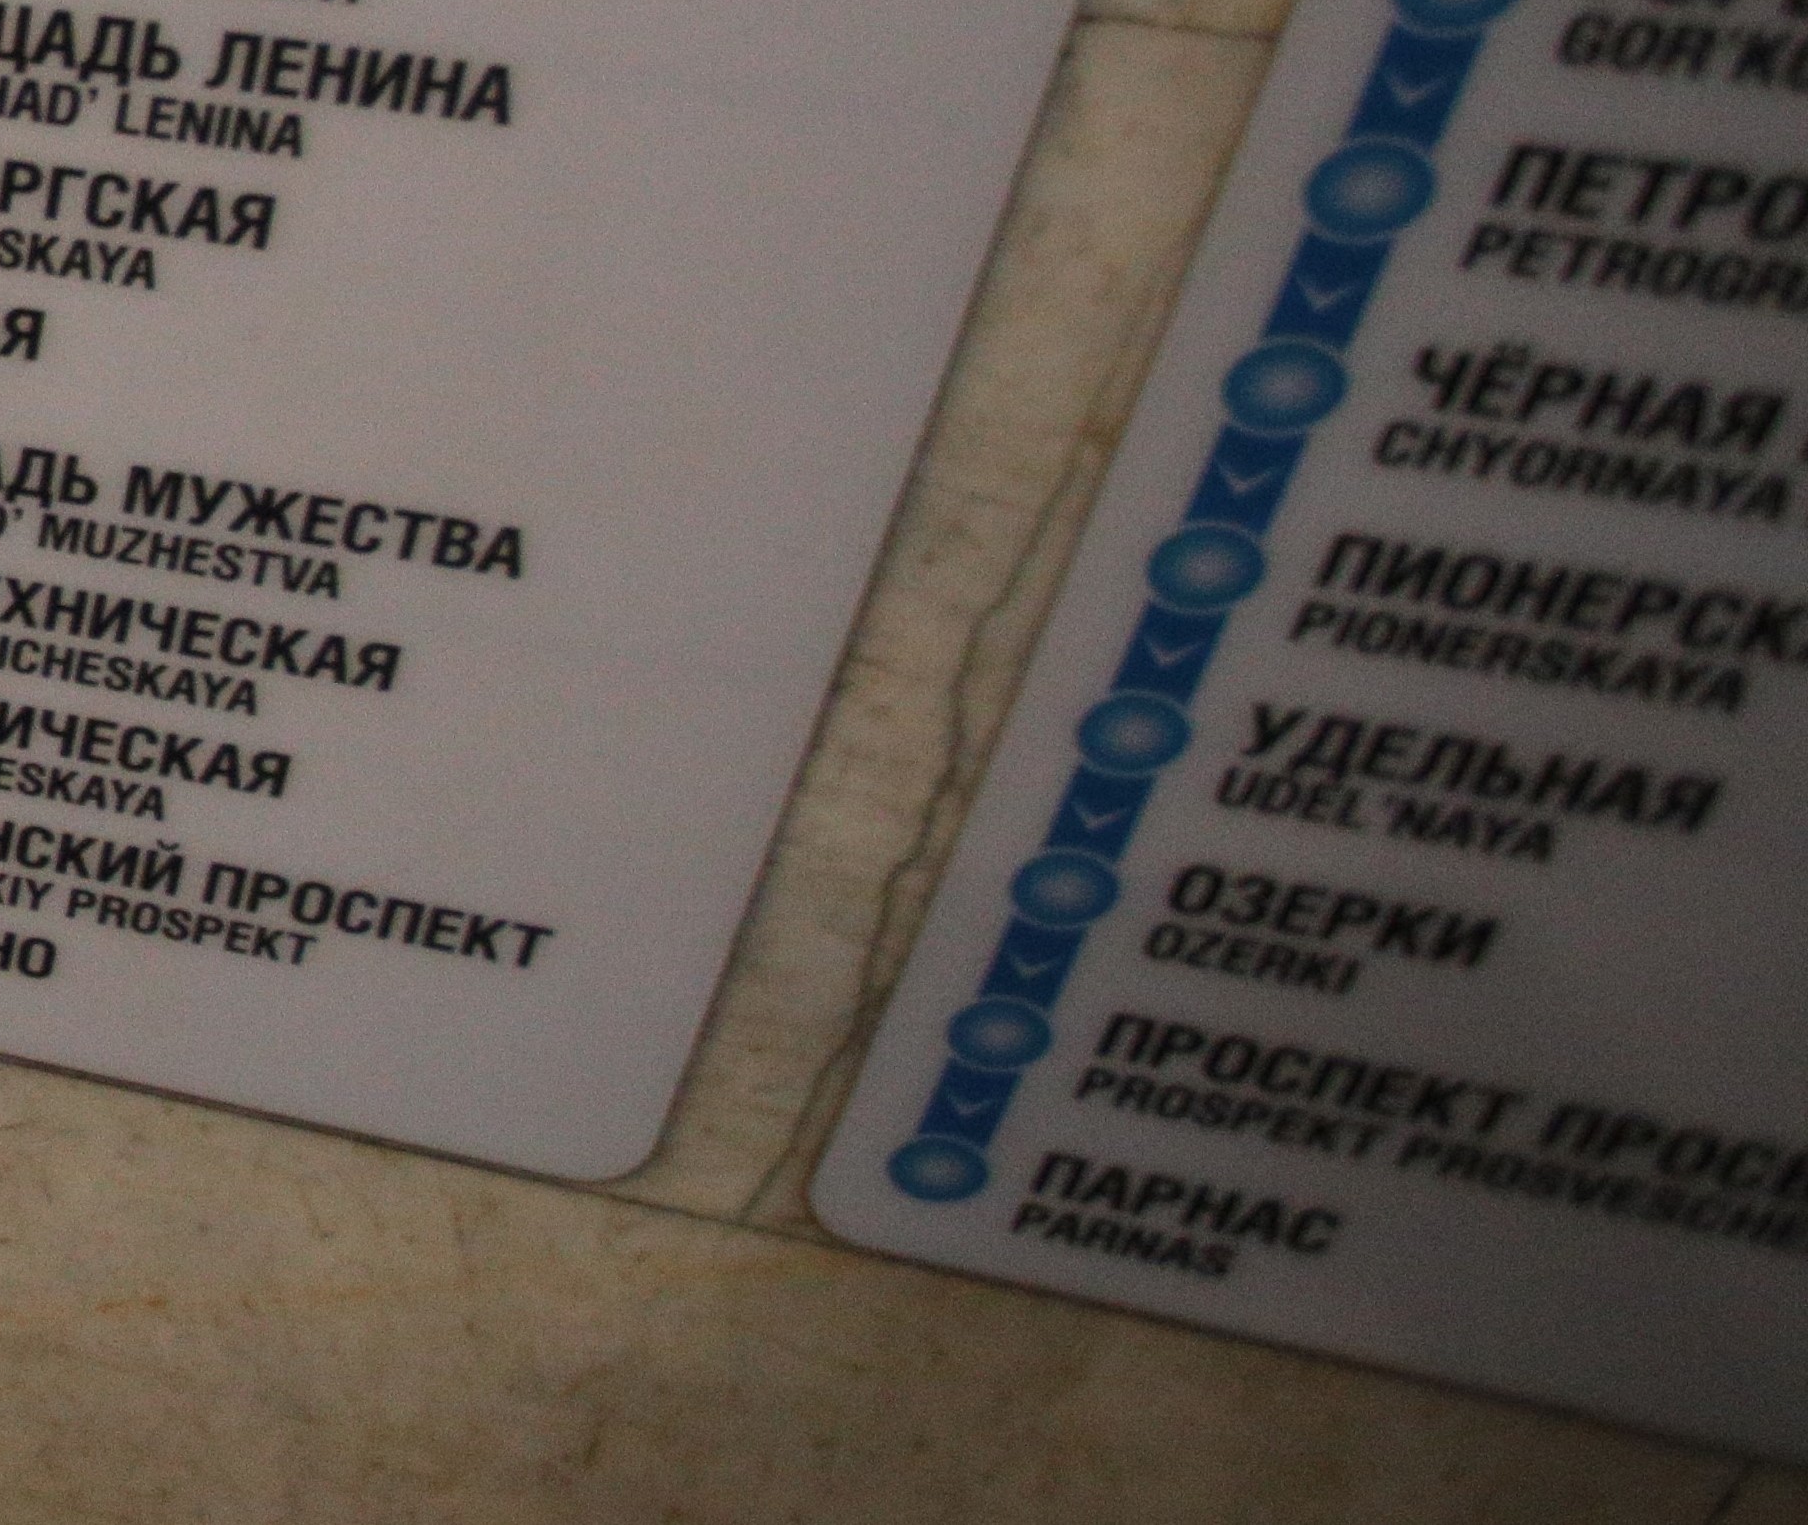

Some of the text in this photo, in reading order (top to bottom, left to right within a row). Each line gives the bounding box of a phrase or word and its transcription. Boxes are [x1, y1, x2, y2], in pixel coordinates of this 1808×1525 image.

[113, 90, 307, 158] LENINA
[207, 31, 517, 127] ЛЕНИНА
[1414, 339, 1785, 453] ЧЁРНАЯ
[1373, 420, 1792, 518] CHYORNAYA
[38, 515, 343, 599] MUZHESTVA
[120, 466, 527, 580] МУЖЕСТВА
[1314, 532, 1808, 668] ПИОНЕРСК
[1290, 604, 1749, 715] PIONERSKAYA
[1241, 702, 1725, 834] УДЕЛЬНАЯ
[66, 886, 317, 966] PROSPEKT
[203, 861, 554, 970] ПРОСПЕКТ
[1144, 923, 1362, 995] OZERKI
[1167, 864, 1501, 971] ОЗЕРКИ
[1074, 1069, 1384, 1160] PROSPEKT
[1096, 1011, 1524, 1137] ПРОСПЕКТ
[1013, 1202, 1239, 1275] PARNAS
[1031, 1151, 1342, 1257] ПАРНАС
